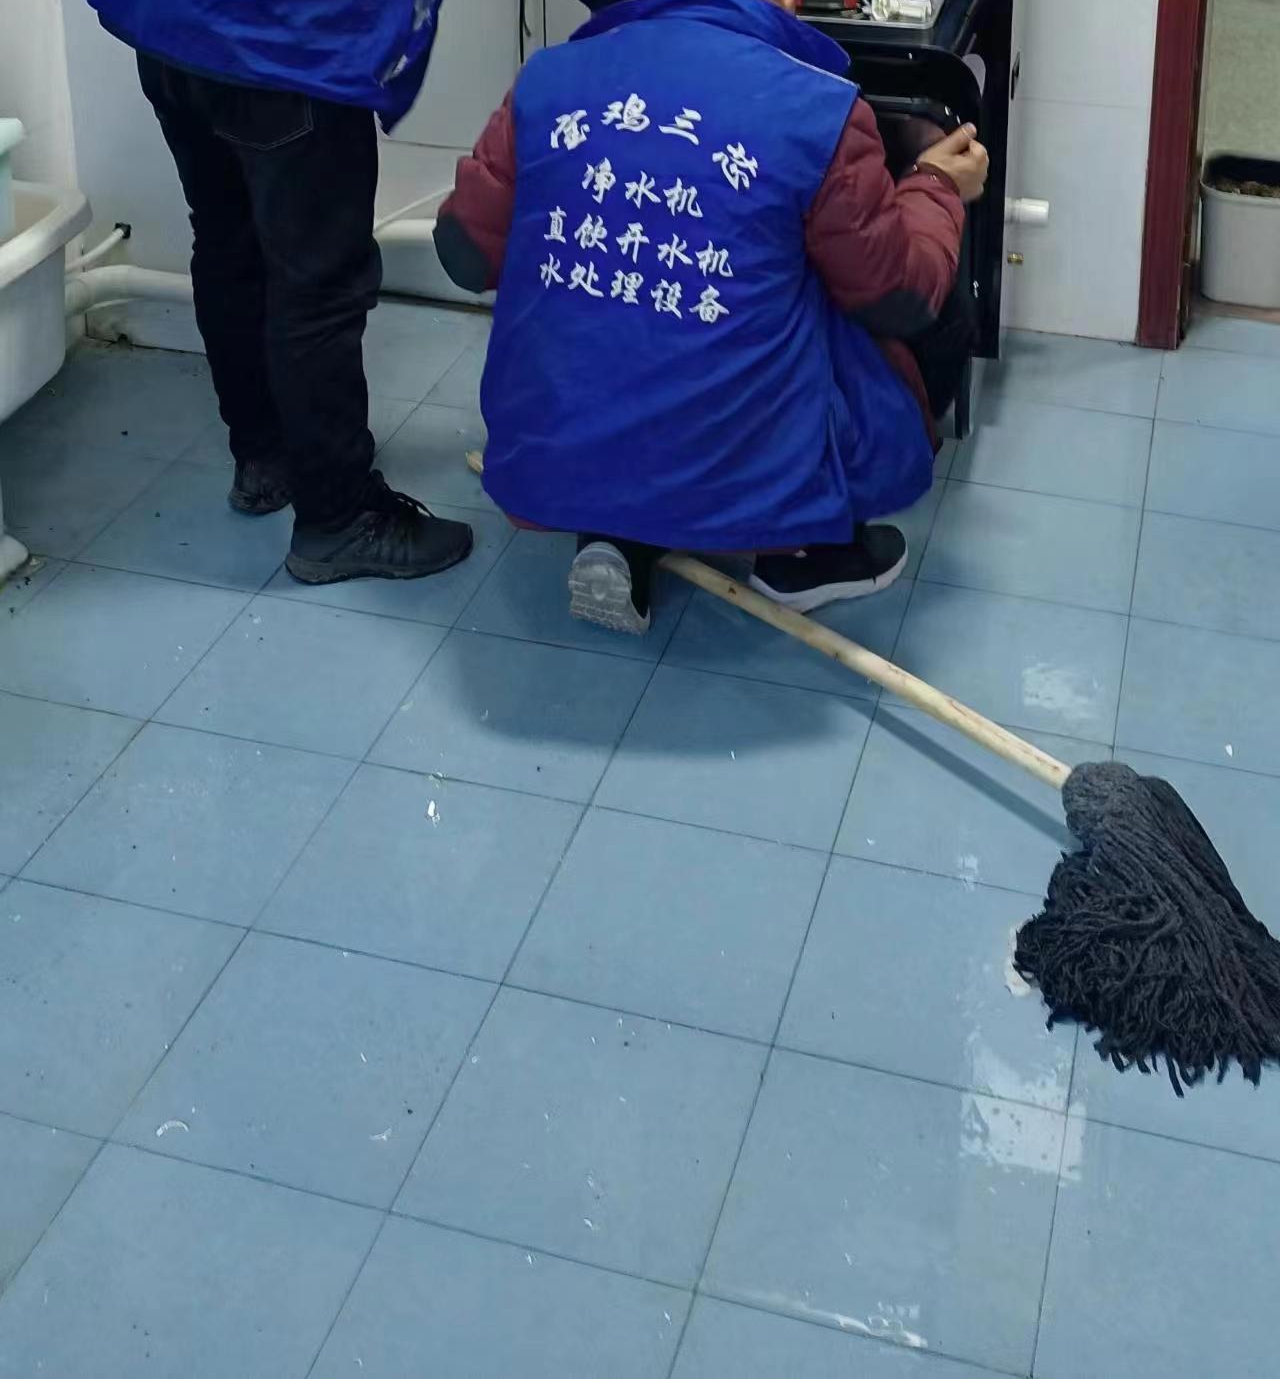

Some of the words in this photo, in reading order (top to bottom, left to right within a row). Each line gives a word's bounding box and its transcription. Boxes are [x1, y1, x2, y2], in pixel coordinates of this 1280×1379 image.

[581, 157, 703, 218] 净水机
[543, 206, 734, 278] 直饮开水机
[539, 252, 730, 324] 水处理设备
